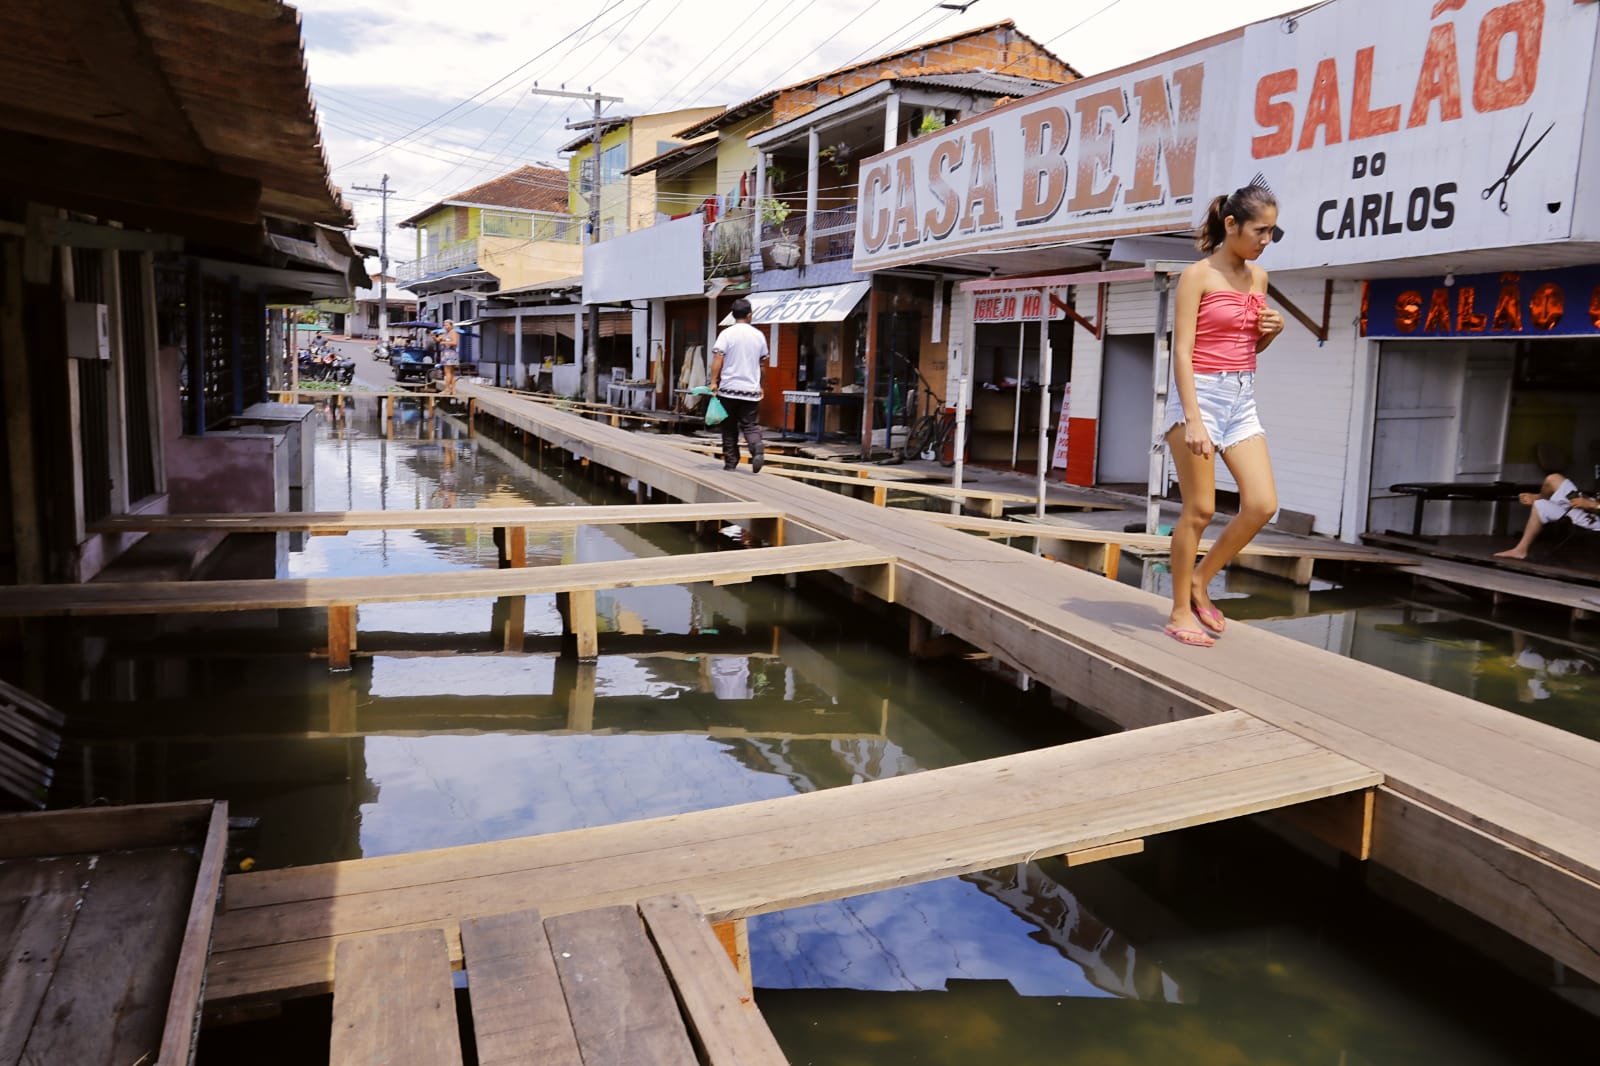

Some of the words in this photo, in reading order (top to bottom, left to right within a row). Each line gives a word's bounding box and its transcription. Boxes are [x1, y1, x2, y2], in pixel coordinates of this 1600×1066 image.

[1251, 0, 1545, 160] SALÃO
[862, 128, 1003, 255] CASA
[1015, 62, 1205, 227] BEN
[1352, 152, 1387, 180] DO
[1316, 182, 1458, 241] CARLOS
[798, 289, 821, 302] DO
[973, 296, 1016, 321] IGREJA
[1395, 271, 1565, 333] SALÃO
